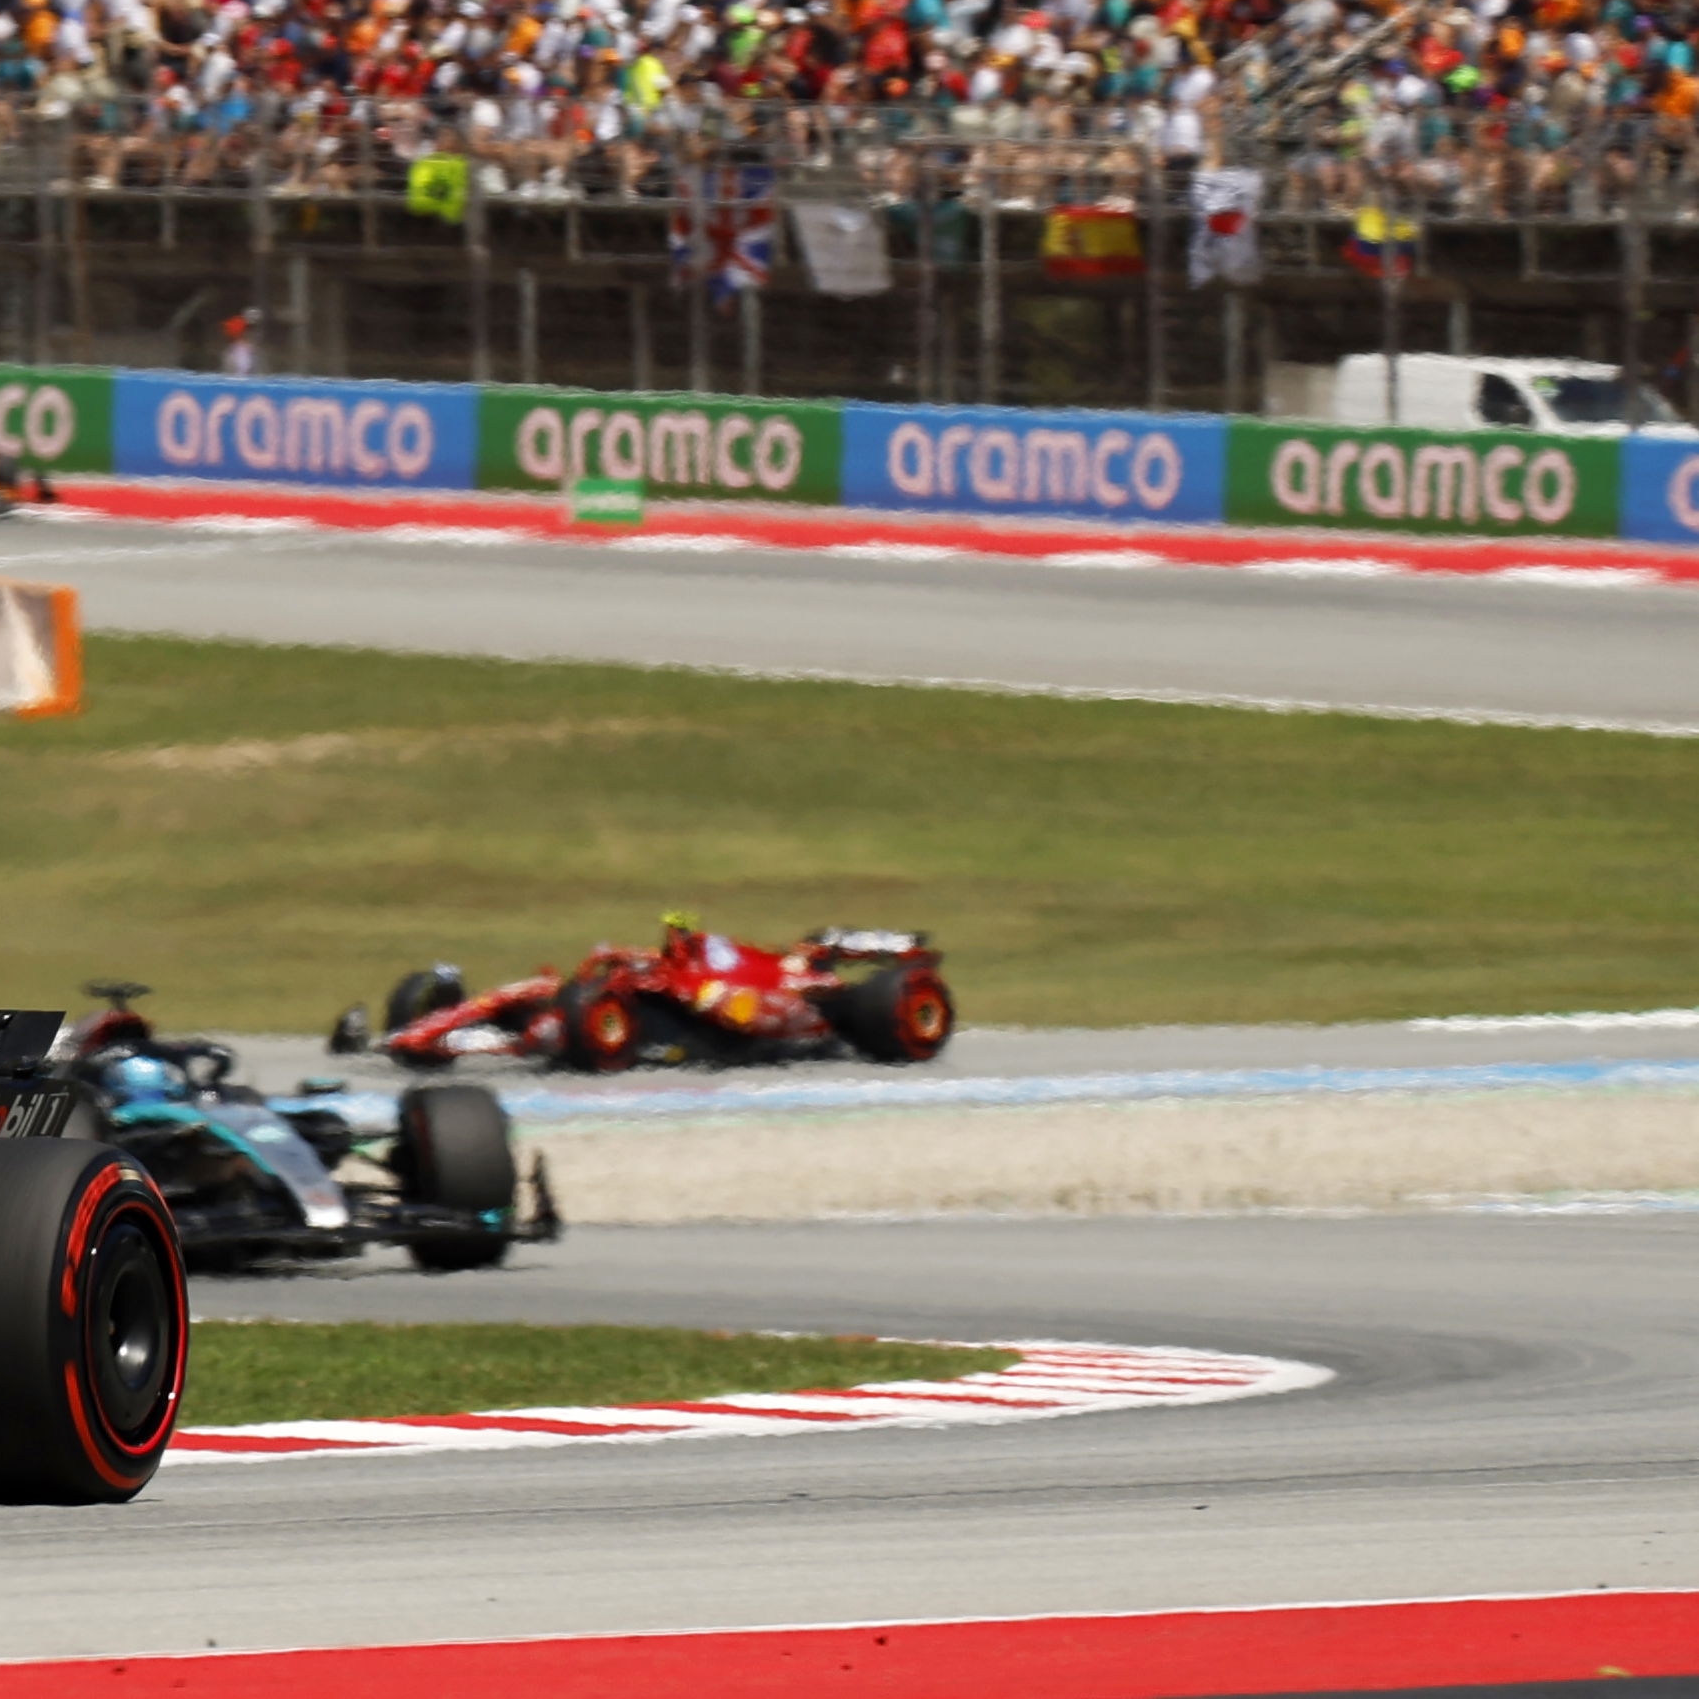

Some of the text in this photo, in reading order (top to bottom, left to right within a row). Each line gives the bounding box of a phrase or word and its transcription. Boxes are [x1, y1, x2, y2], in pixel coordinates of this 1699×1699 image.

[156, 389, 433, 479] aramco
[516, 405, 803, 490] aramco
[887, 421, 1182, 510] aramco
[1270, 437, 1577, 523] aramco
